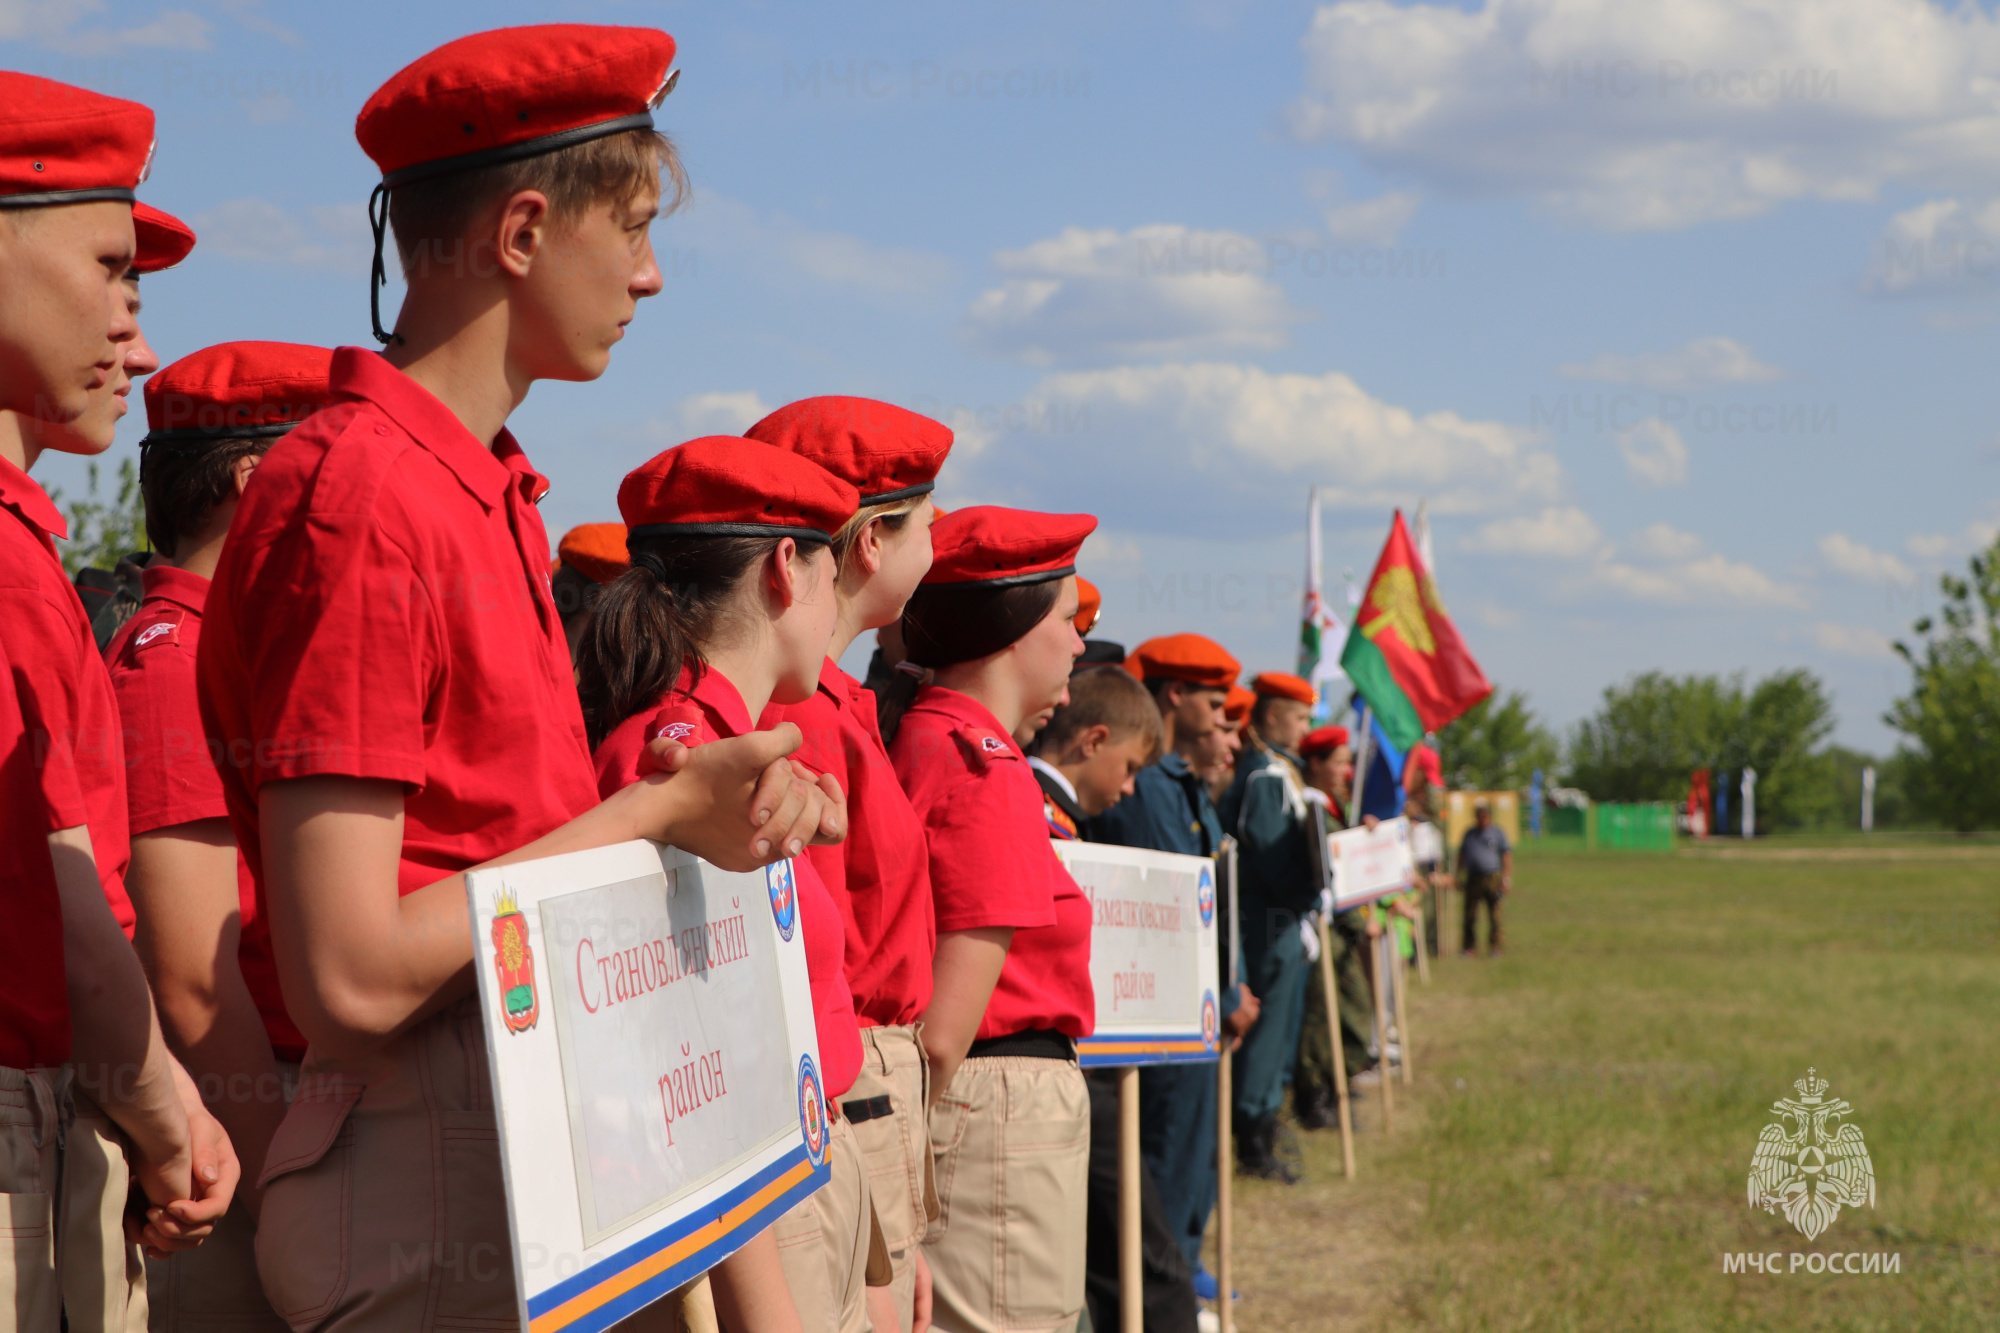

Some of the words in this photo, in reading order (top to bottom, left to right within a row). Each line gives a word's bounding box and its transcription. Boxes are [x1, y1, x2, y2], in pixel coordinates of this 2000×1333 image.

[576, 895, 749, 1014] Становлянский
[1112, 961, 1156, 1012] район
[658, 1041, 727, 1147] район
